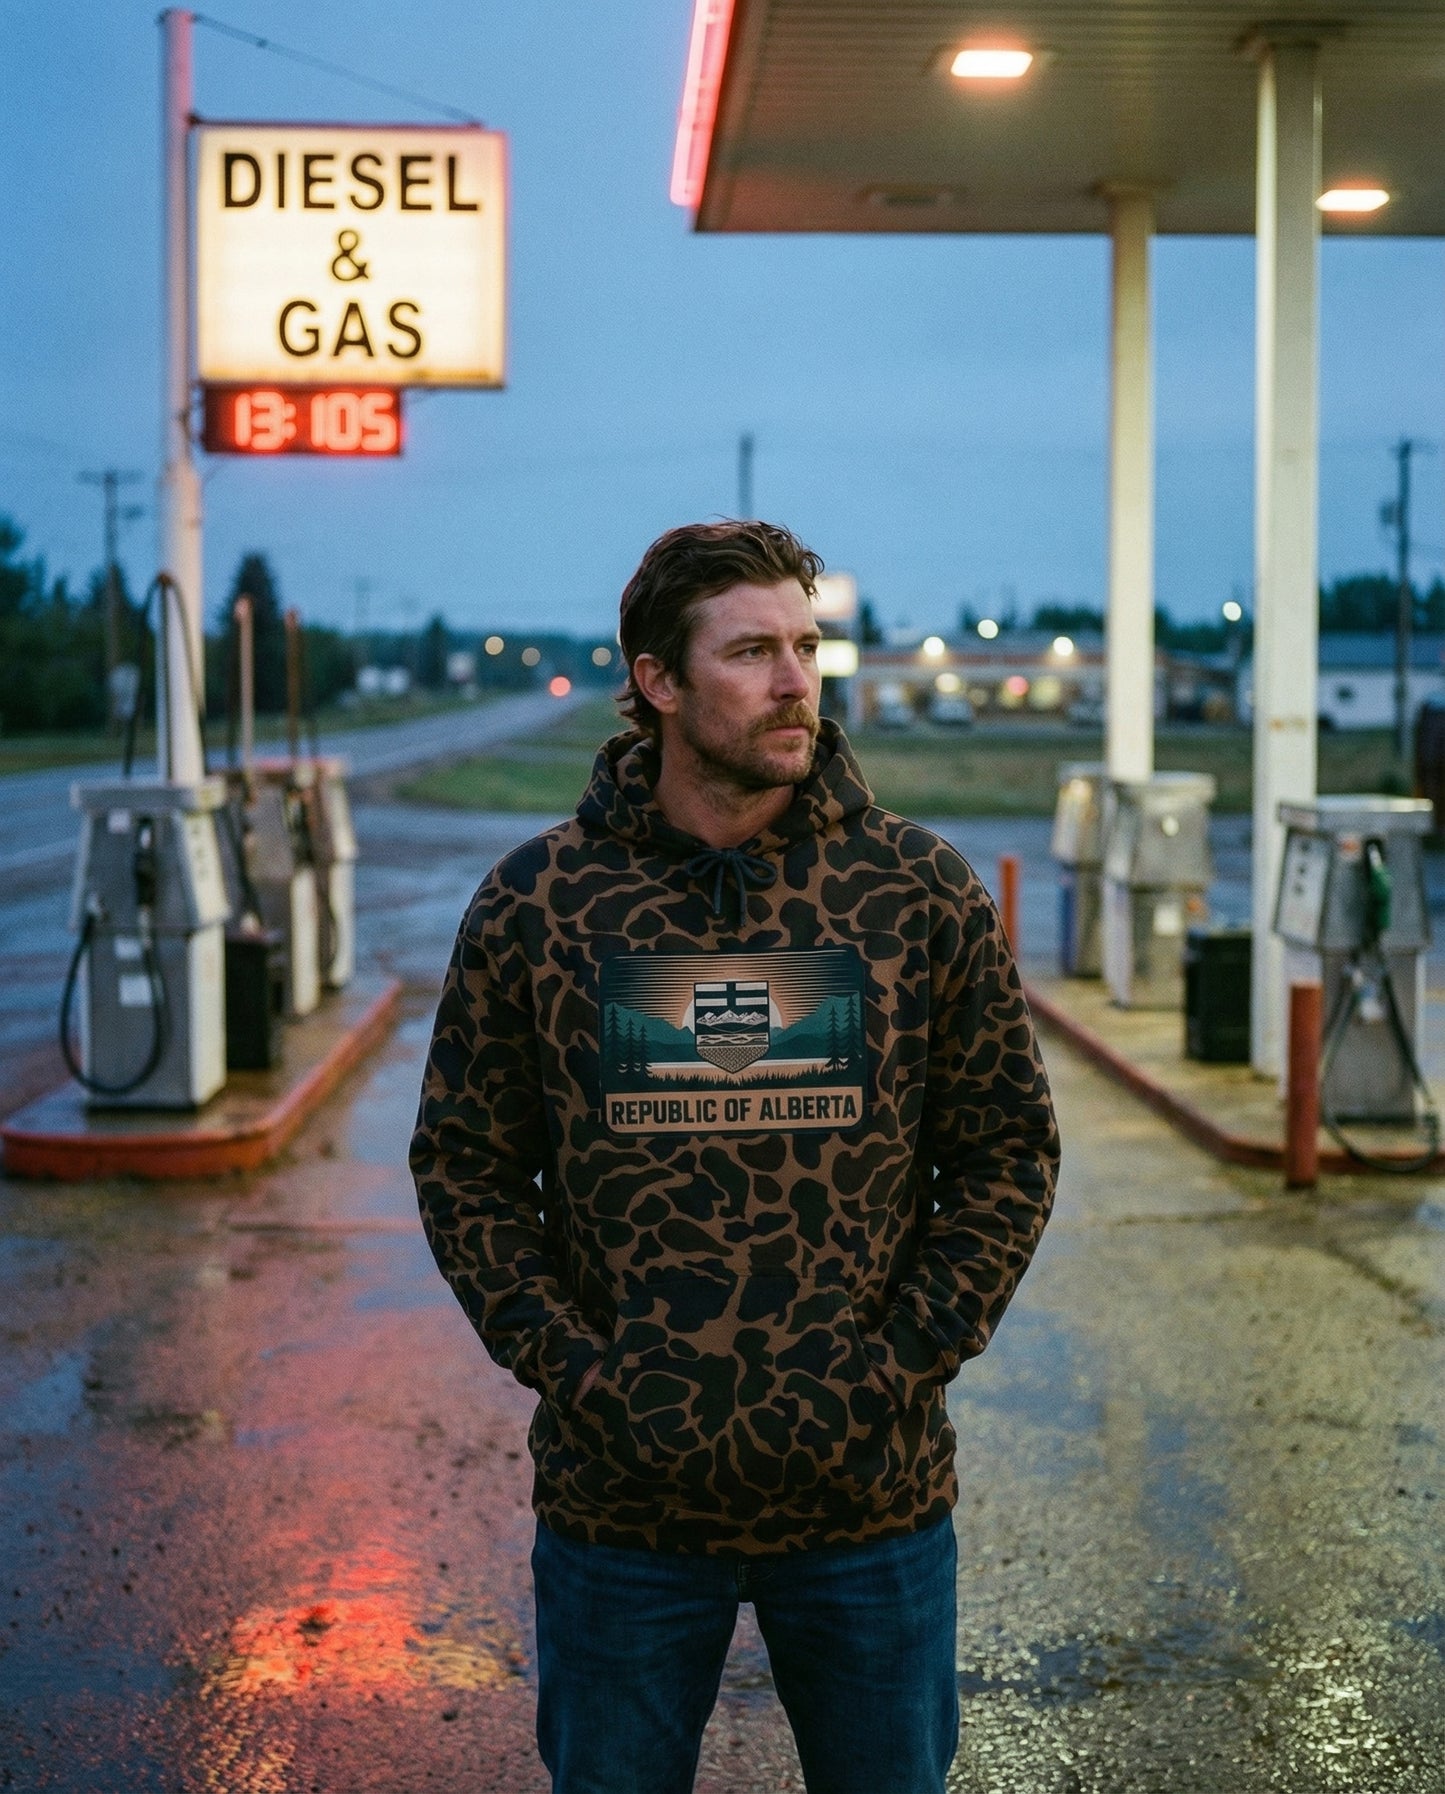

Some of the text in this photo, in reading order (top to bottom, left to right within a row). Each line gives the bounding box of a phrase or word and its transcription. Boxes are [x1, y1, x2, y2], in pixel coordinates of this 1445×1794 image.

[223, 152, 480, 211] DIESEL
[331, 229, 370, 281] &
[278, 300, 422, 358] GAS
[611, 1094, 857, 1125] REPUBLIC OF ALBERTA
